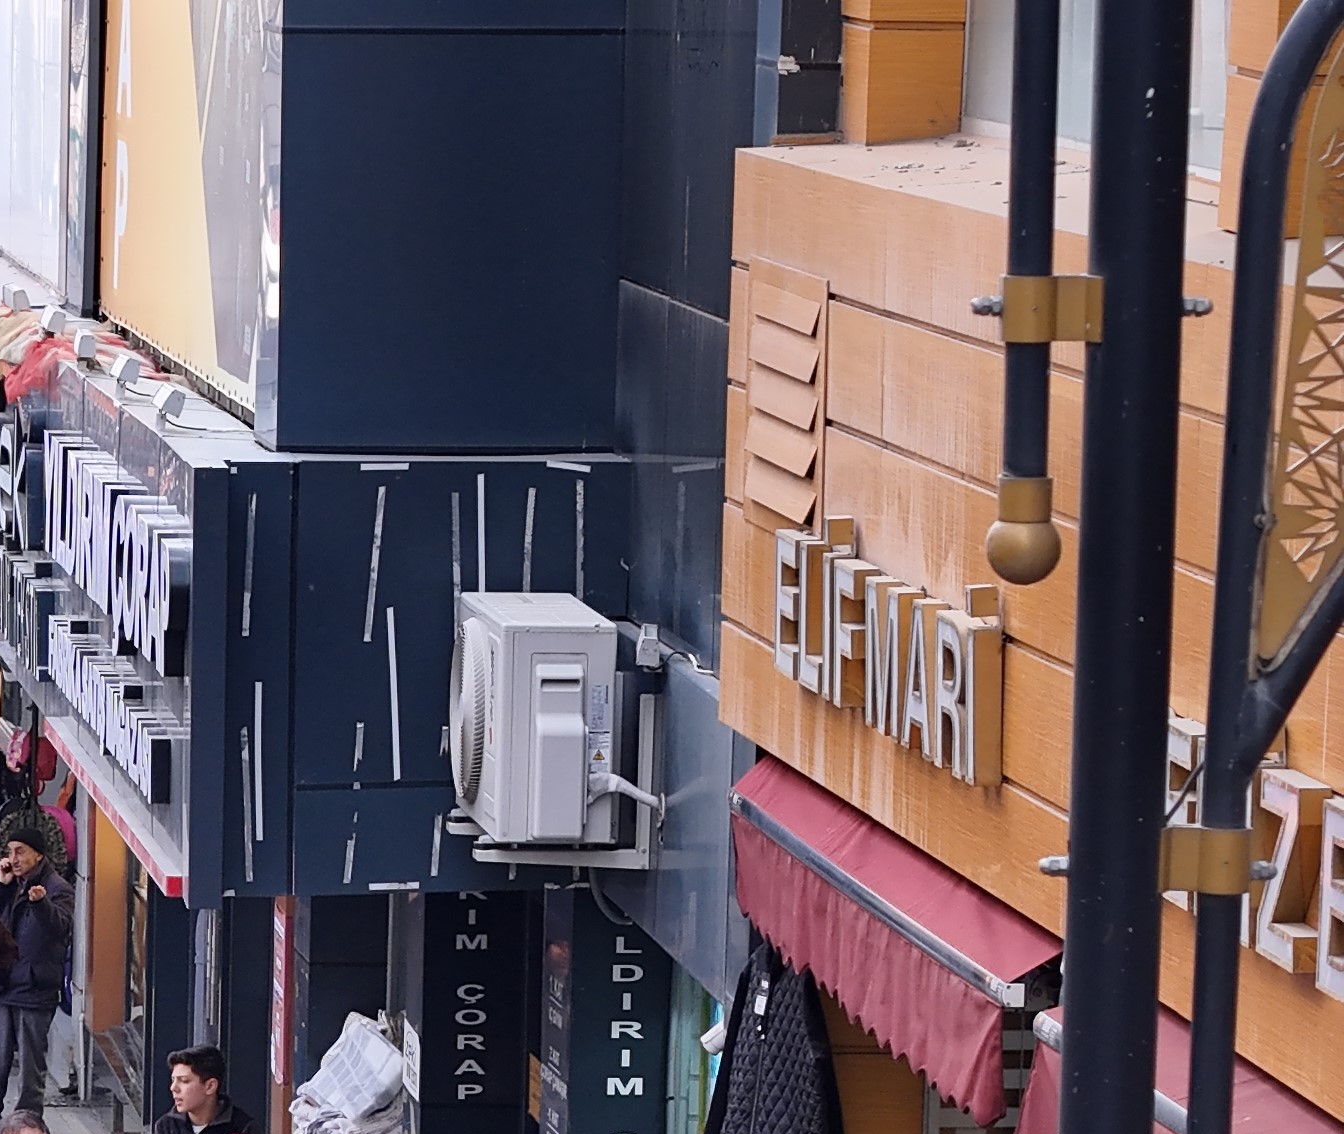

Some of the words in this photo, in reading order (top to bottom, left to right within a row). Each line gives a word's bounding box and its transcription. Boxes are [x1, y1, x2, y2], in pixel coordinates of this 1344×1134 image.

[44, 430, 124, 615] YILDIRIM
[112, 494, 180, 678] ÇORAP
[454, 983, 487, 1100] ÇORAP
[605, 937, 644, 1096] LDIRIM
